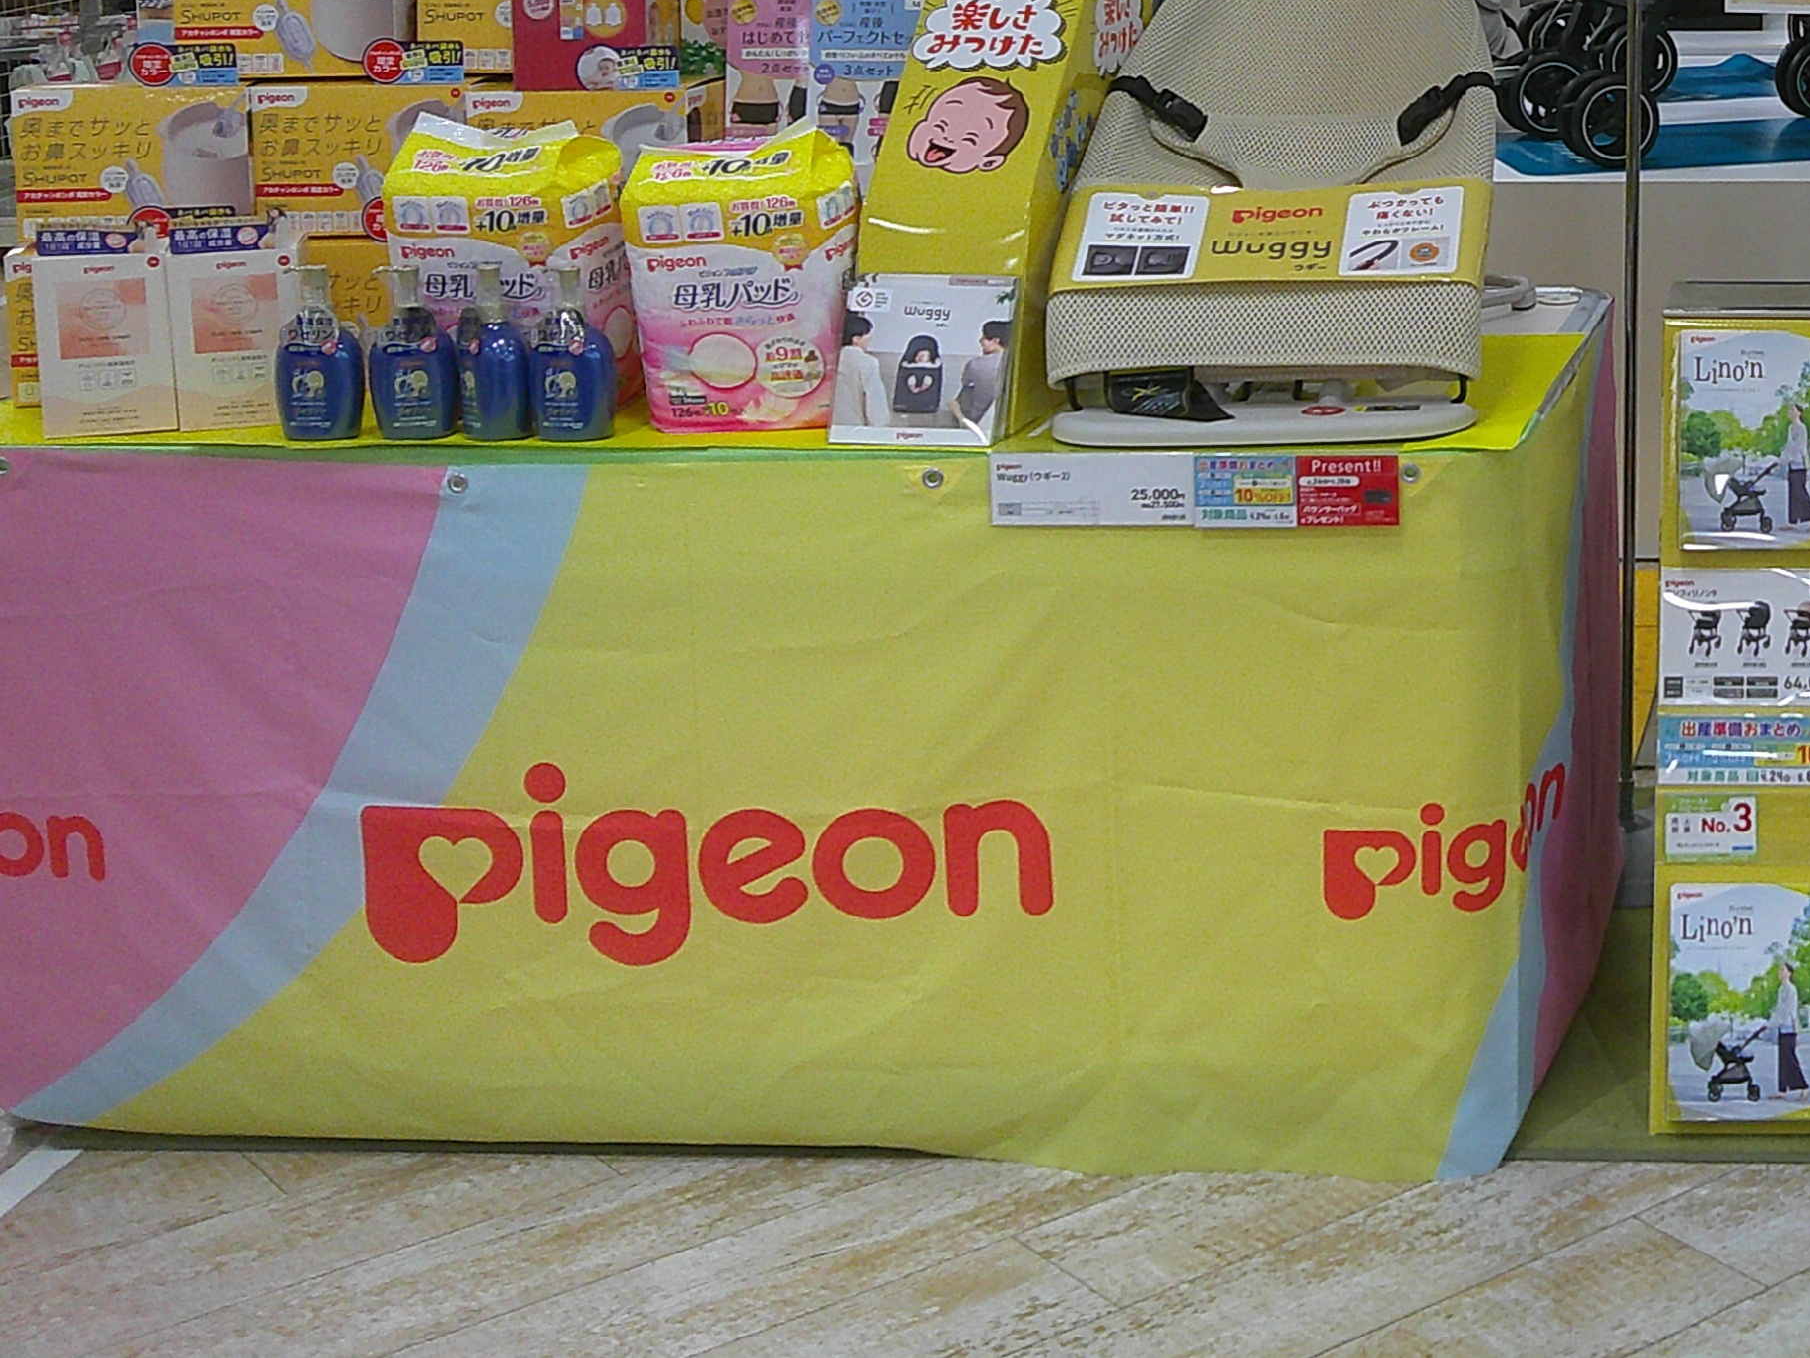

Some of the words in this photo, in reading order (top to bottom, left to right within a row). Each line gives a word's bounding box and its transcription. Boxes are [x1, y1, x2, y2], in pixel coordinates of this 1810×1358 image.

[180, 10, 242, 24] SHUPOT
[424, 9, 484, 24] SHUPOT
[952, 0, 1037, 31] 楽しさ
[927, 33, 1044, 56] みつけた
[17, 96, 59, 108] pigeon
[258, 92, 295, 103] pigeon
[472, 97, 510, 109] pigeon
[19, 117, 151, 139] 奥までサッと
[260, 113, 381, 134] 奥までサッと
[20, 142, 152, 160] お鼻スッキリ
[260, 138, 382, 157] お鼻スッキリ
[23, 173, 87, 185] SHUPOT
[262, 168, 321, 181] SHUPOT
[1367, 195, 1445, 210] ぶつかっても
[1232, 206, 1323, 225] pigeon
[401, 246, 455, 260] pigeon
[1211, 239, 1332, 261] Wuggy
[83, 266, 115, 274] pigeon
[215, 261, 247, 270] pigeon
[646, 255, 707, 272] pigeon
[425, 273, 543, 298] 母乳ッド
[673, 279, 801, 311] 母乳パッド
[904, 306, 950, 321] Wuggy
[1694, 356, 1764, 385] Lino'n
[1665, 579, 1694, 588] pigeon
[361, 762, 1055, 966] pigeon
[1681, 913, 1753, 942] Lino'n
